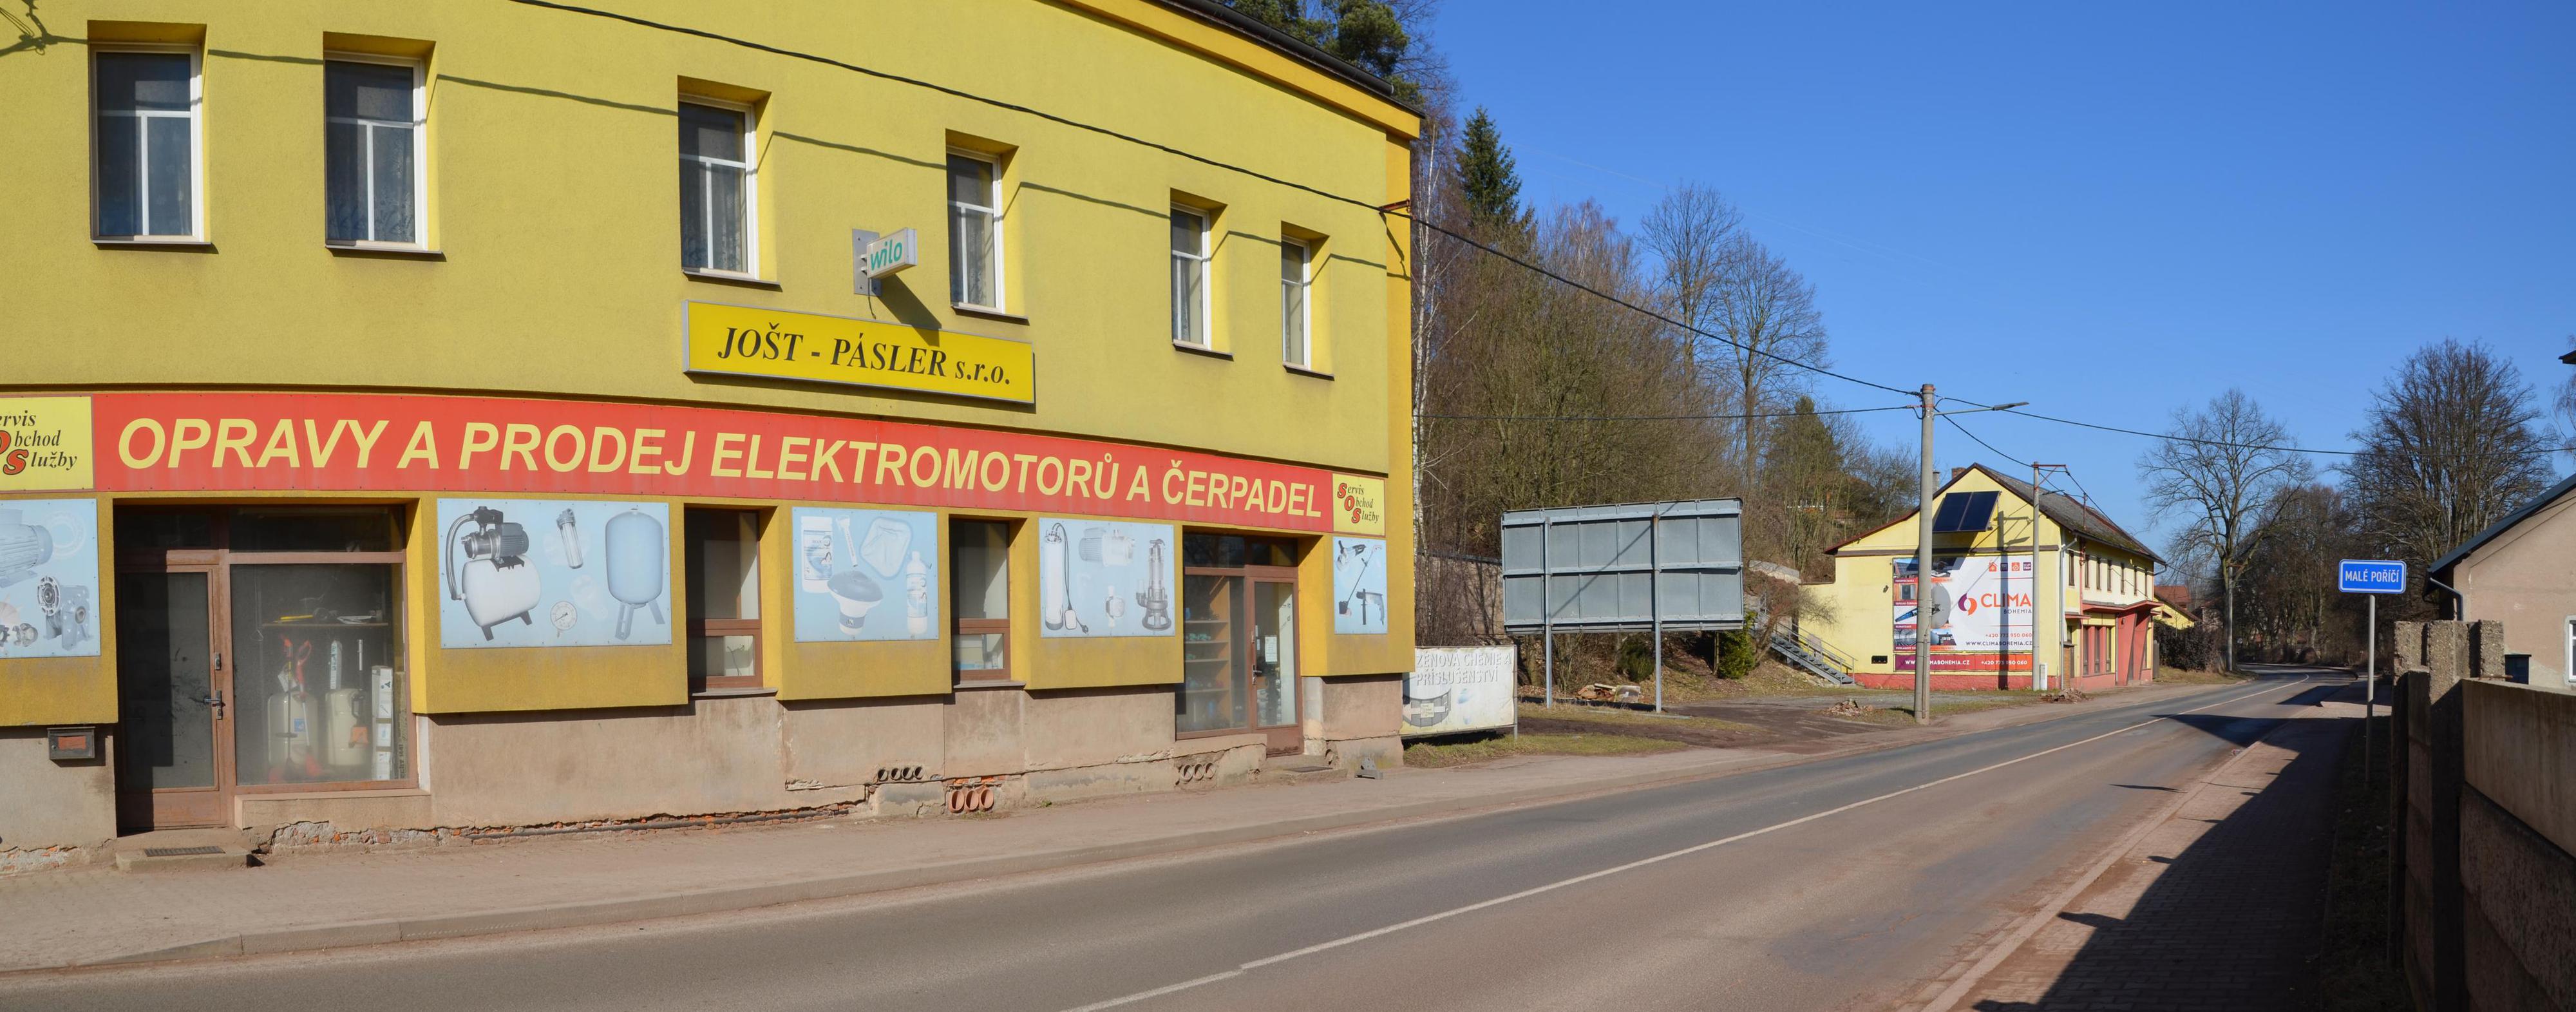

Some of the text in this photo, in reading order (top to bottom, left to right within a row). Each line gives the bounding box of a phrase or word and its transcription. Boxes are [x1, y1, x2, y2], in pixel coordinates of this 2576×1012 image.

[870, 242, 902, 271] wilo
[717, 322, 803, 361] JOŠT
[830, 333, 947, 377] PÁSLER
[954, 360, 1010, 385] s.r.o.
[3, 448, 77, 475] Služby
[118, 417, 1322, 518] OPRAVY A PRODEJ ELEKTROMOTORŮ A ČERPADEL
[1337, 482, 1365, 499] Servis
[1344, 495, 1374, 511] Obchod
[1351, 508, 1379, 524] Služby
[2345, 569, 2400, 582] MALÉ POŘÍČÍ
[1980, 593, 2032, 607] CLIMA
[1416, 650, 1511, 668] ZÉNOVÁ CHEMIE A
[1416, 667, 1499, 686] PŘÍSLUŠENSTVÍ
